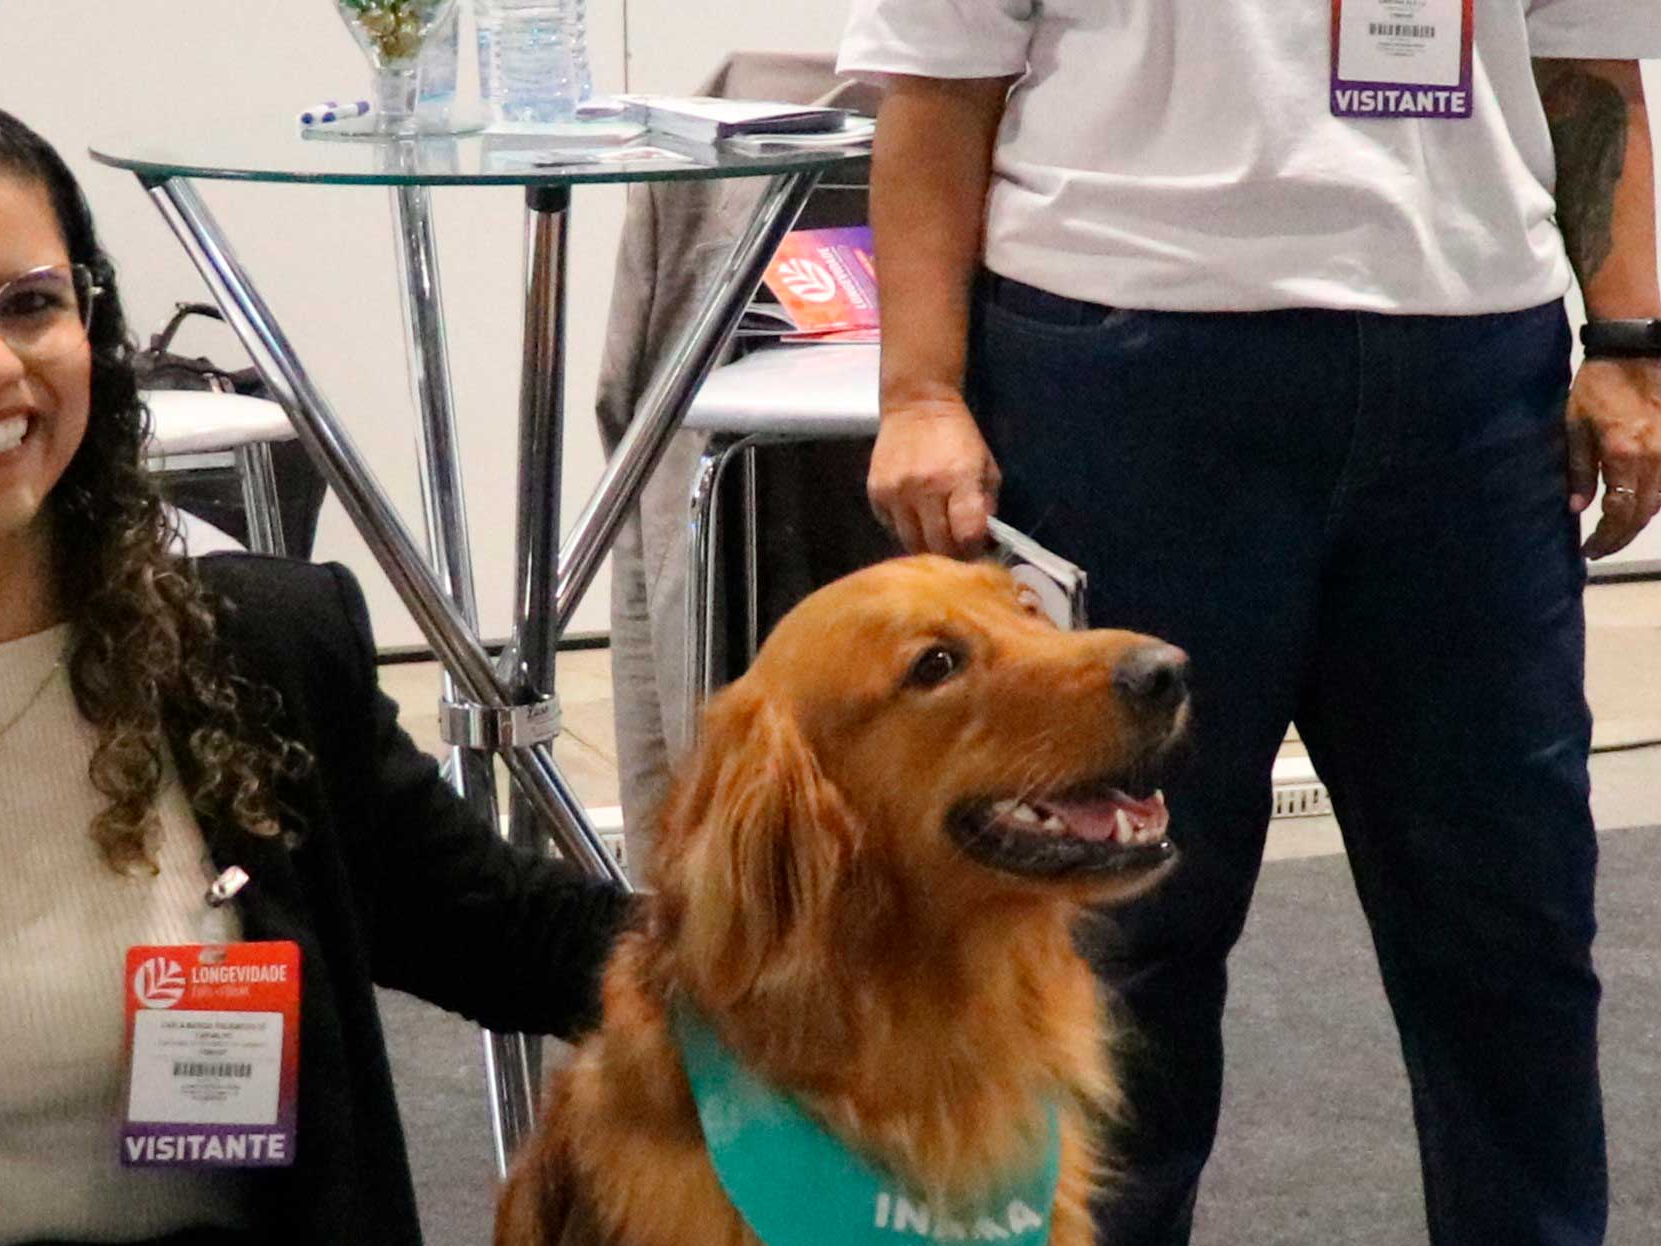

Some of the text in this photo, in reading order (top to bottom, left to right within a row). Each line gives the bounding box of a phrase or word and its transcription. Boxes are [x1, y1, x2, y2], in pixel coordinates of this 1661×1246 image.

[1335, 89, 1466, 113] VISITANTE
[191, 964, 288, 983] LONGEVIDADE
[125, 1133, 286, 1162] VISITANTE
